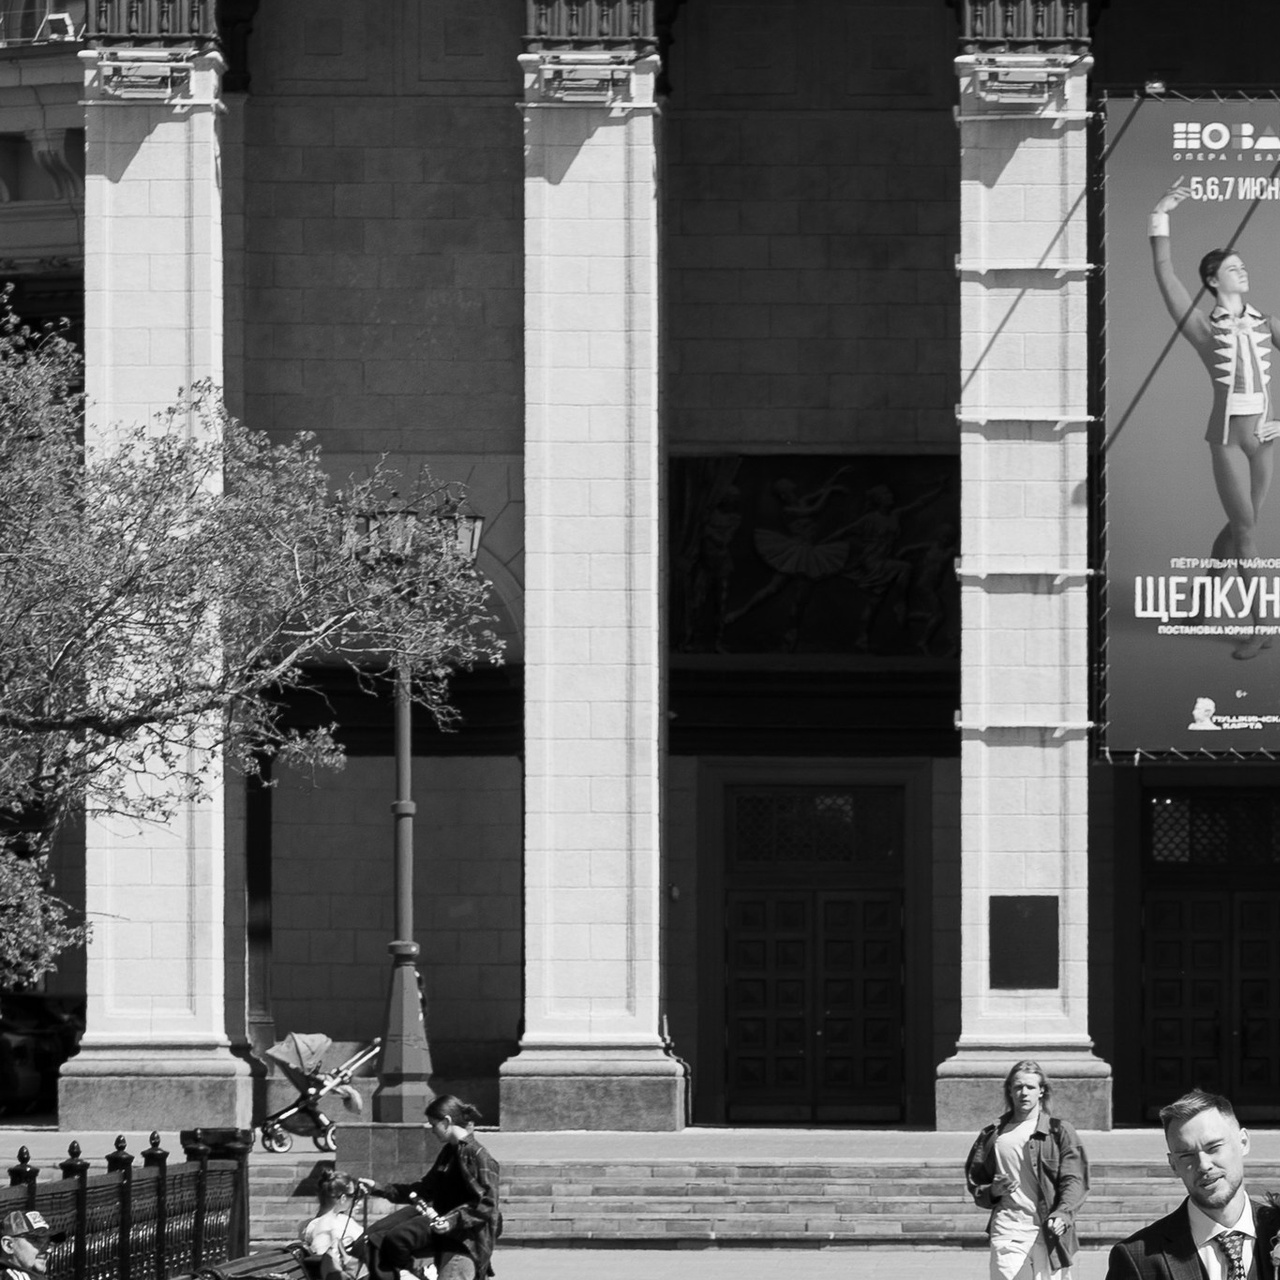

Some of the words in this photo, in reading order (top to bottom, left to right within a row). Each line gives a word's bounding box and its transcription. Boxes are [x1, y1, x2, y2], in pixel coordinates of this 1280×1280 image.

[1200, 558, 1238, 569] ИЛЬИЧ
[1158, 624, 1224, 636] ПОСТАНОВКА
[1225, 625, 1254, 635] ЮРИЯ
